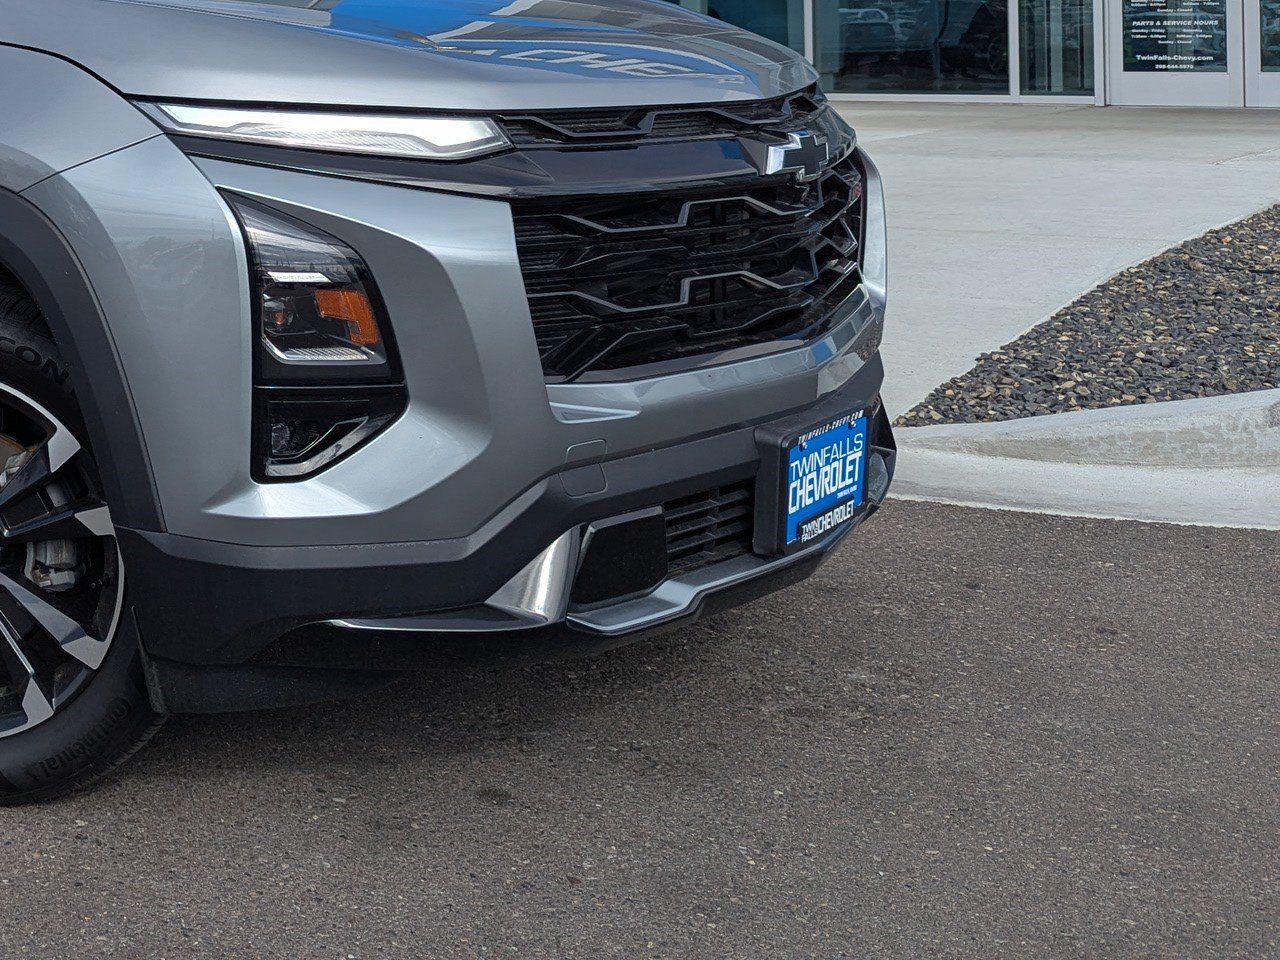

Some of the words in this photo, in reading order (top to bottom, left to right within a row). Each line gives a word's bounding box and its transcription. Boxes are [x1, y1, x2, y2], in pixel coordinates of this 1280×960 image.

[790, 433, 863, 481] TWINFALLS
[788, 450, 862, 515] CHEVROLET
[817, 500, 855, 535] CHEVROLET
